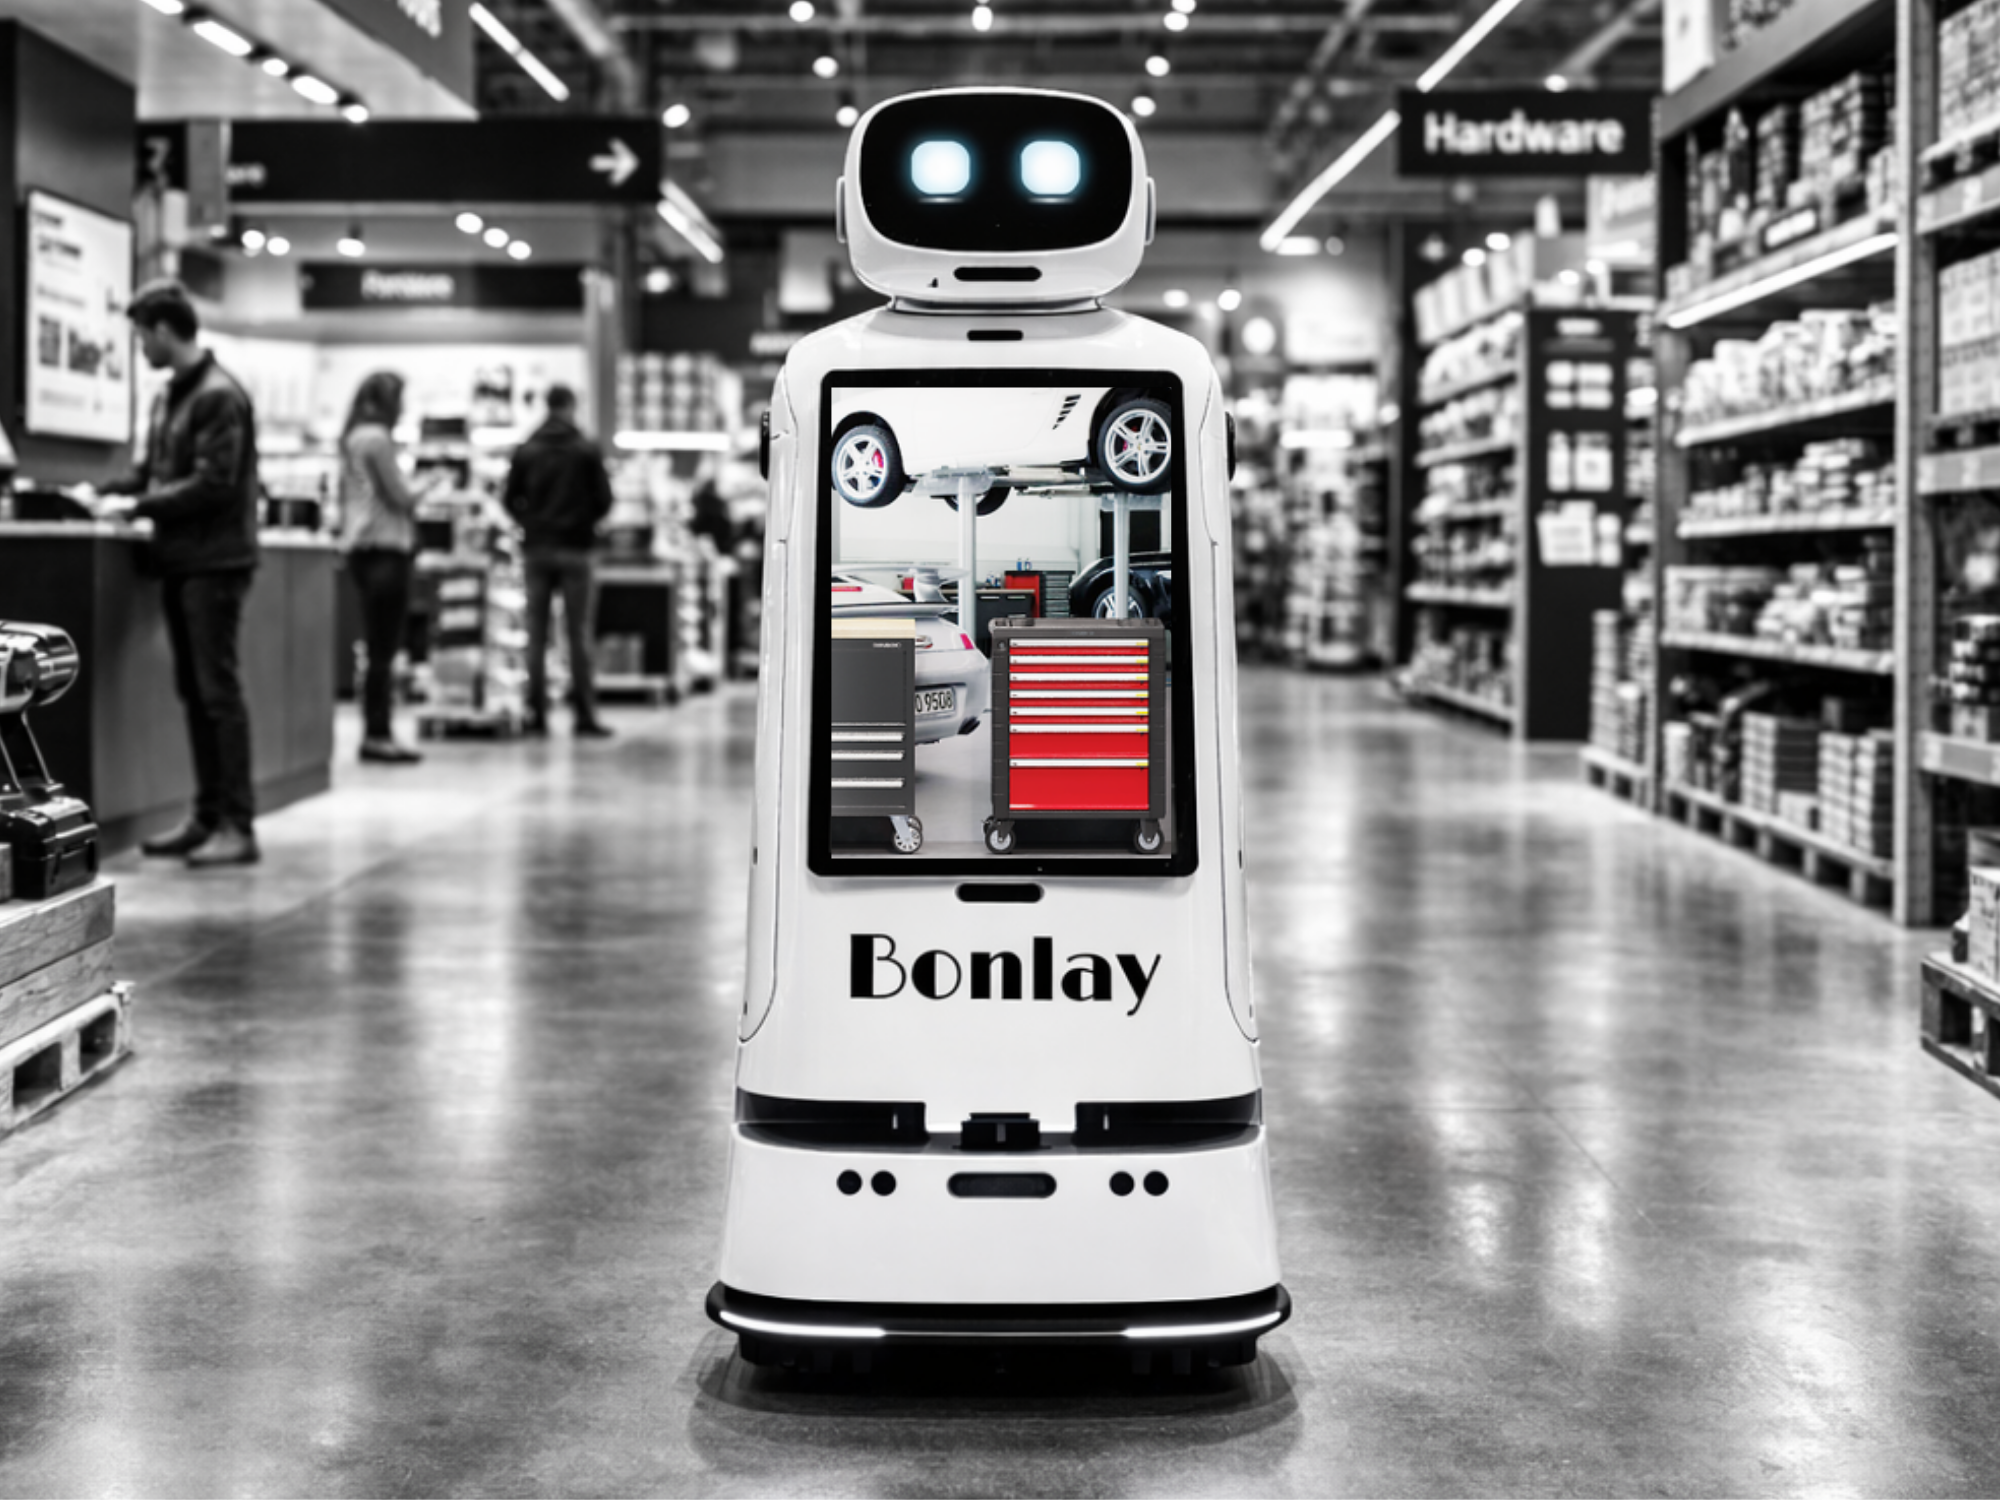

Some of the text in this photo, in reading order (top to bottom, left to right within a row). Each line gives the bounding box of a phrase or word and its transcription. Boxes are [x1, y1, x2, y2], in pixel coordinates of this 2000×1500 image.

[1424, 109, 1624, 153] Hardware
[924, 690, 953, 712] 9508
[850, 933, 1161, 1016] Bonlay
